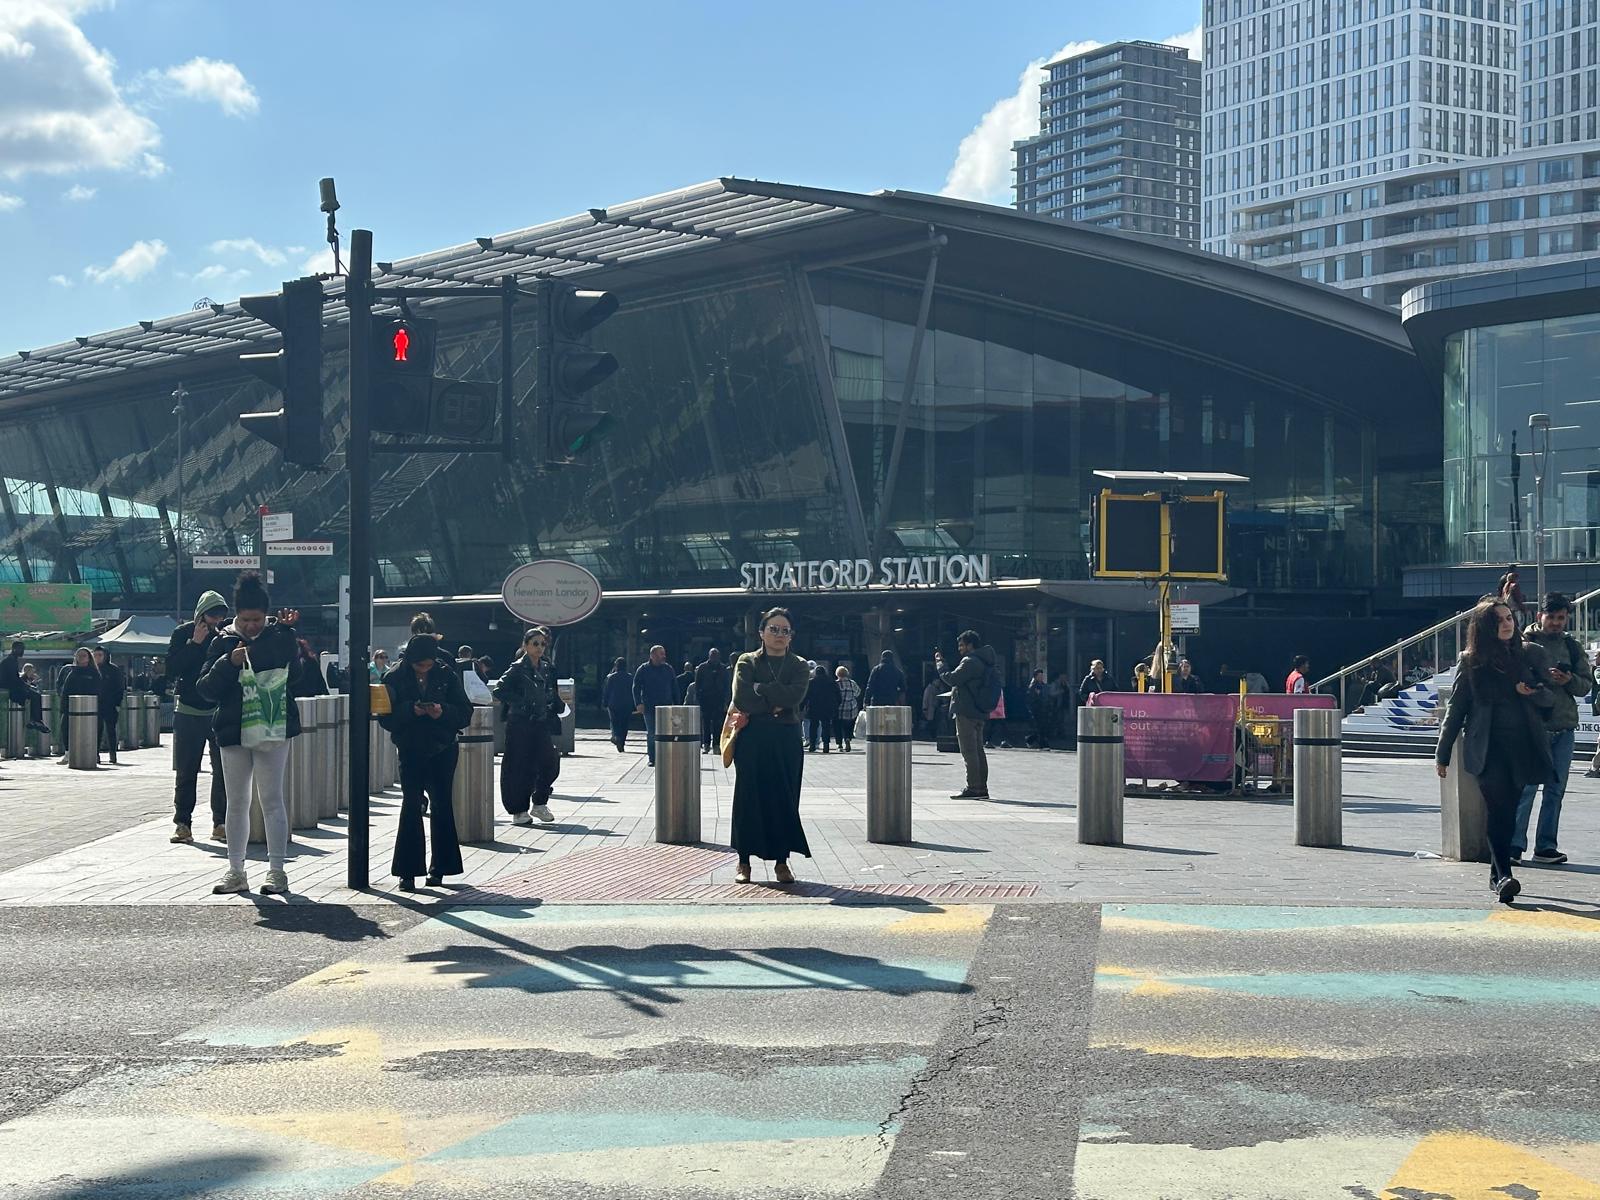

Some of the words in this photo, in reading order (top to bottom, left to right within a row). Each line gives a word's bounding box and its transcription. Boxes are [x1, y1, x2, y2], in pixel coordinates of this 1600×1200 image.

[740, 558, 873, 589] STRATFORD
[879, 554, 991, 587] STATION
[513, 587, 553, 597] Newham
[555, 587, 589, 597] London
[1581, 723, 1593, 731] THE
